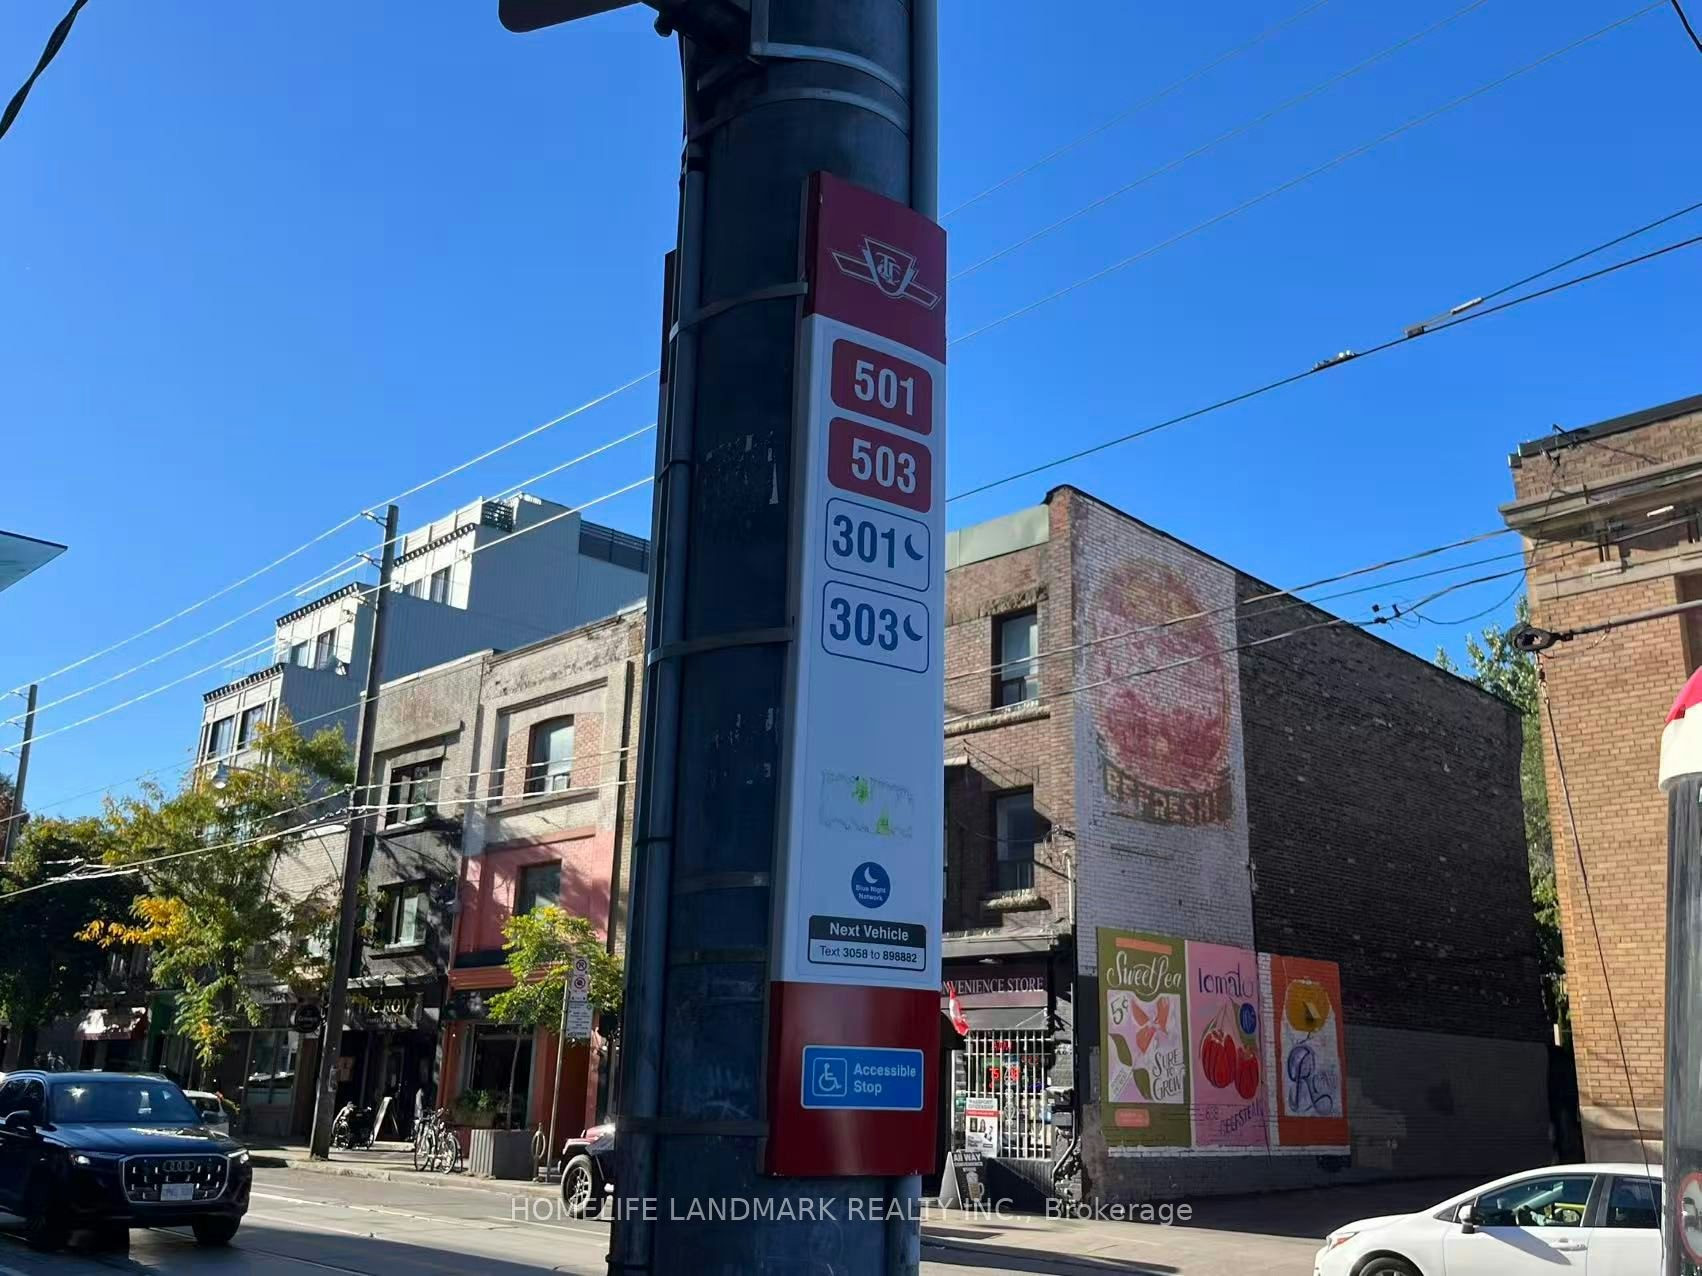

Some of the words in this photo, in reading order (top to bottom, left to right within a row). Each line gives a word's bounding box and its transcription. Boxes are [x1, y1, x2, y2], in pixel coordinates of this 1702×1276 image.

[854, 360, 914, 416] 501
[851, 438, 916, 494] 503
[832, 514, 896, 568] 301
[829, 597, 899, 651] 303
[855, 884, 870, 892] Blue
[870, 885, 886, 895] Night
[858, 892, 884, 902] Network
[829, 922, 860, 937] Next
[863, 924, 910, 941] Vehicle
[819, 945, 841, 957] Text
[842, 947, 869, 959] 3058
[870, 949, 881, 960] to
[882, 950, 918, 963] 898882
[1006, 976, 1045, 993] STORE
[853, 1062, 917, 1078] Accessible
[853, 1079, 883, 1097] Stop
